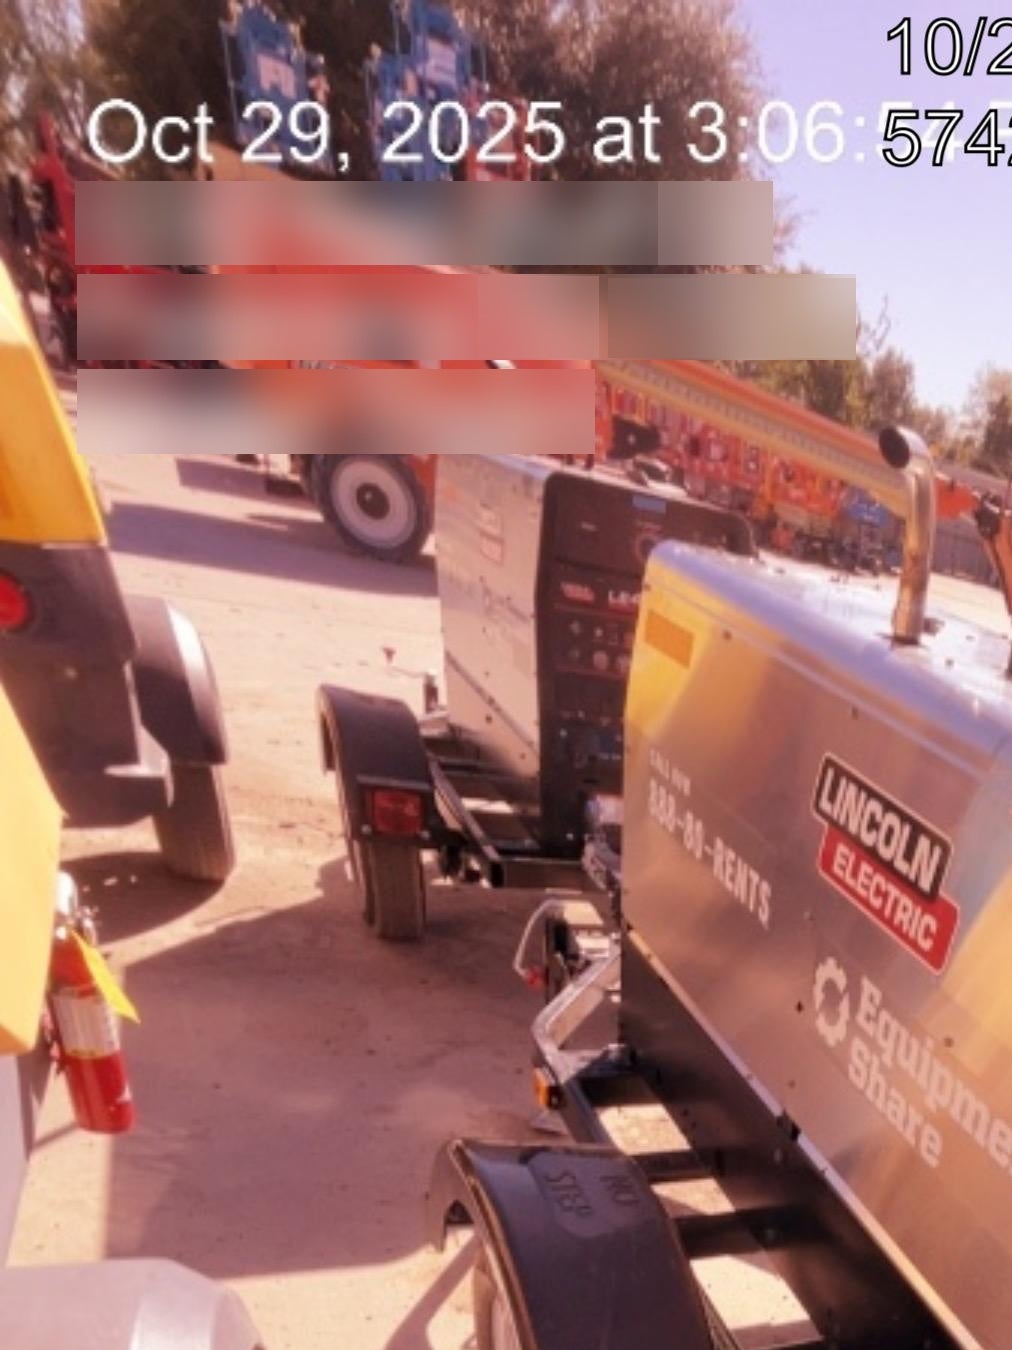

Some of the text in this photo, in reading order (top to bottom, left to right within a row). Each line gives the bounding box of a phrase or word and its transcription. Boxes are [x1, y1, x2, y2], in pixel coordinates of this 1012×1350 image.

[818, 767, 942, 895] LINCOLN
[832, 842, 937, 951] ELECTRIC
[849, 1036, 943, 1168] Share
